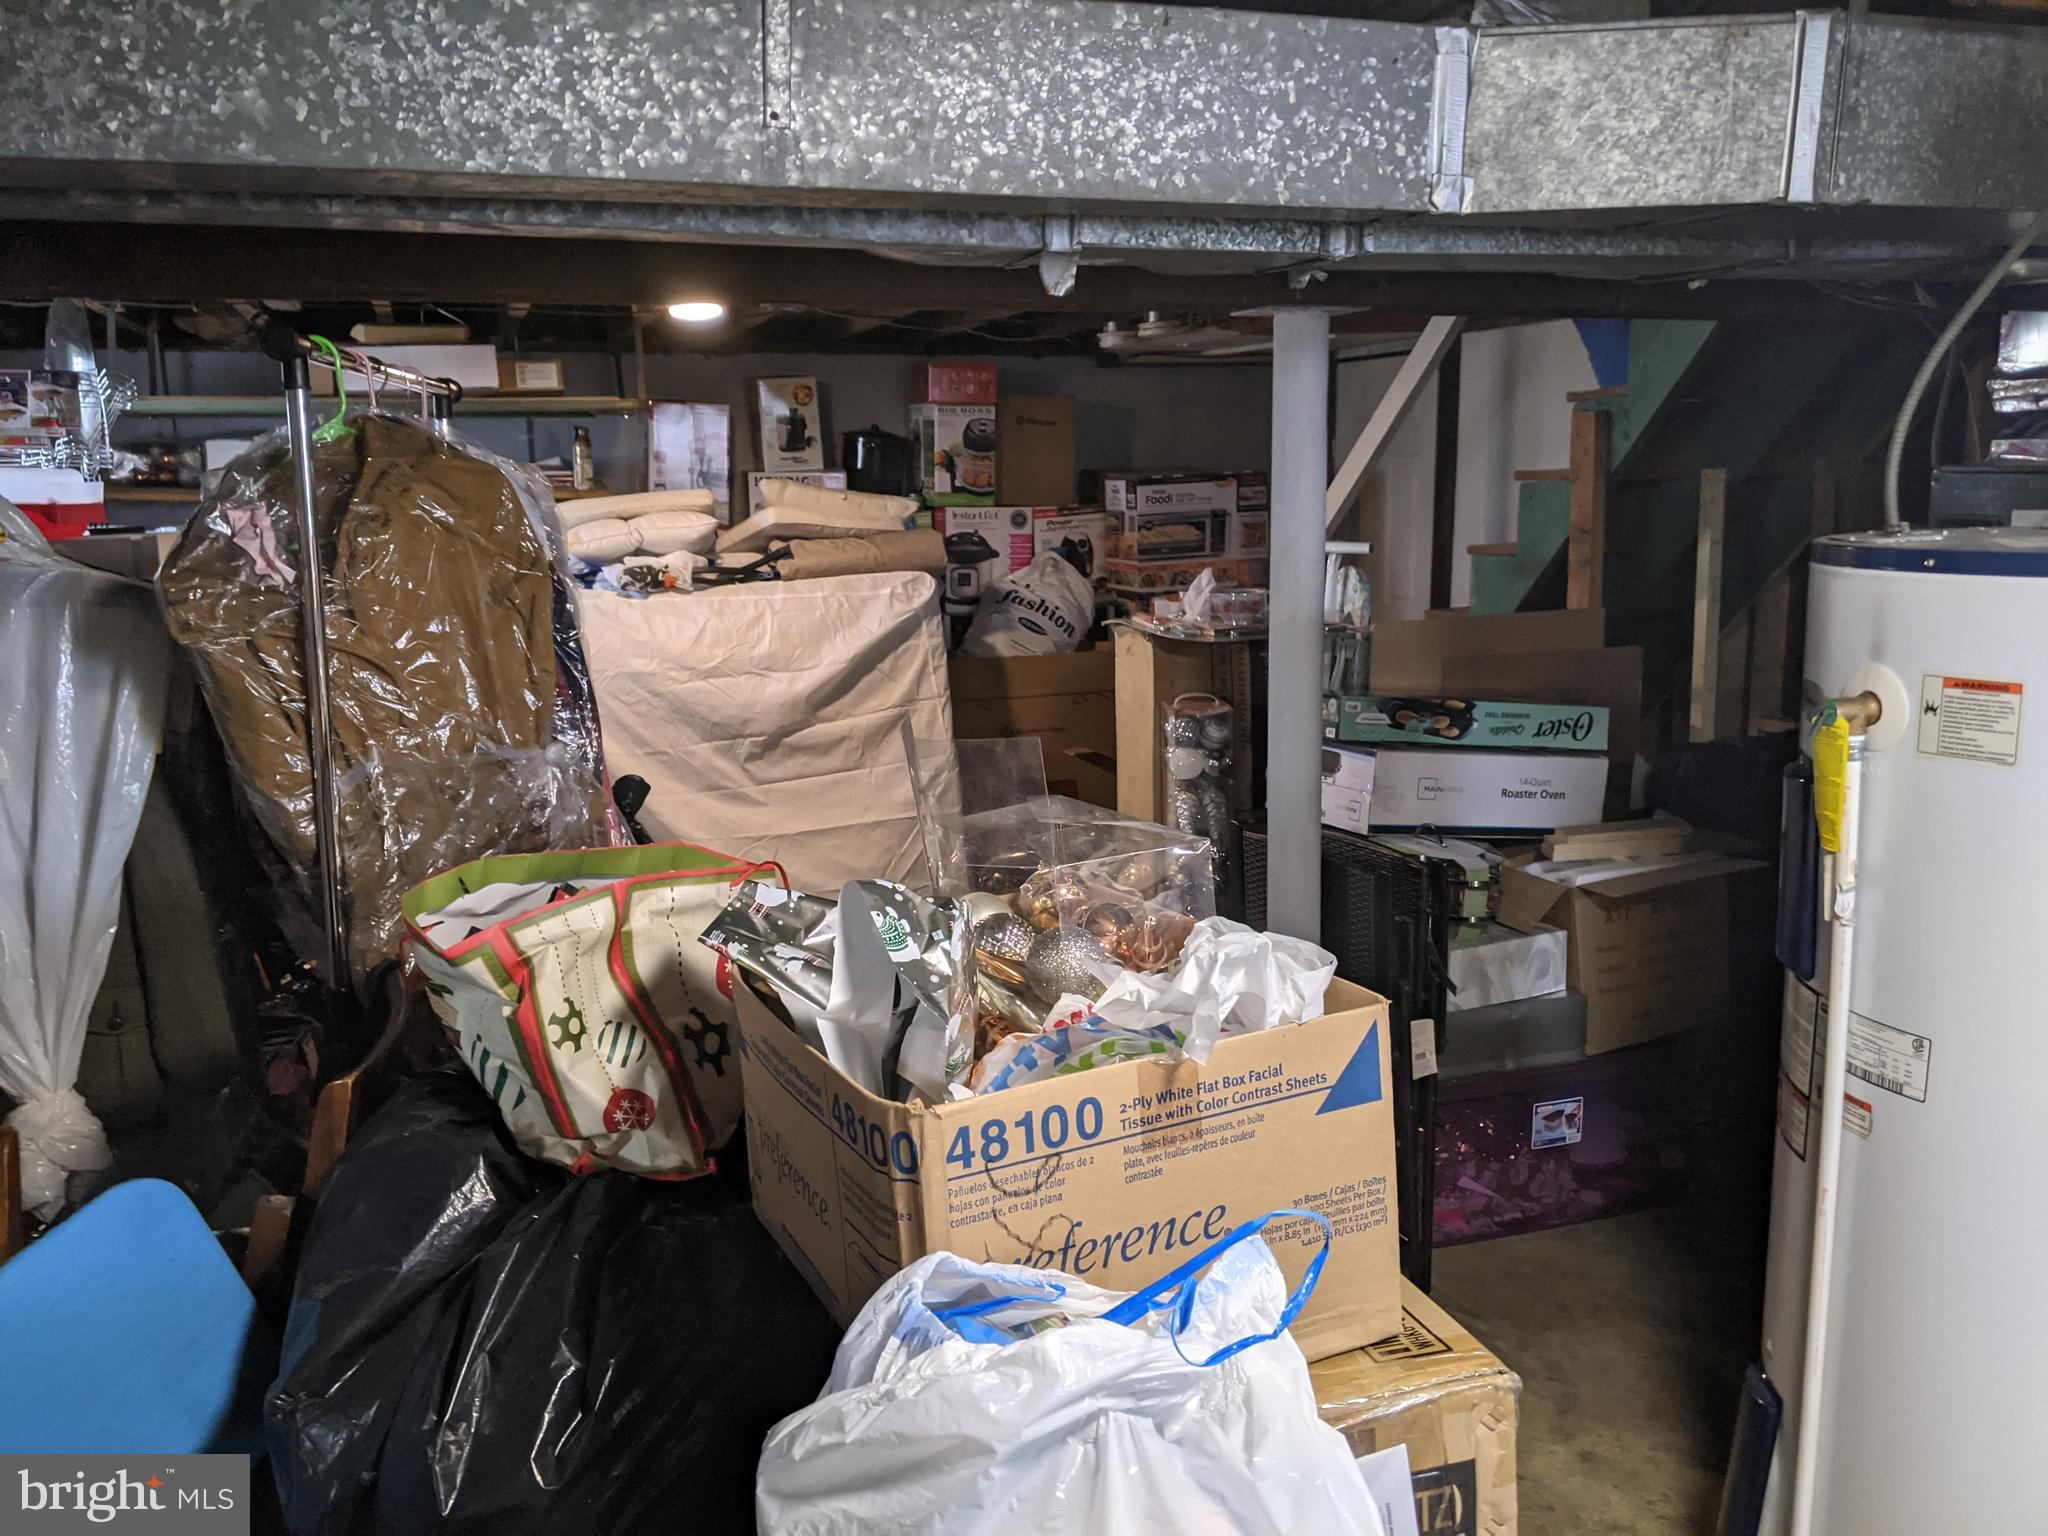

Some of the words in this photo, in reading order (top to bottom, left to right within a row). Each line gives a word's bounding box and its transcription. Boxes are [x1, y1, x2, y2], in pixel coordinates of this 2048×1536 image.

[1145, 494, 1173, 505] Foodi
[996, 589, 1076, 638] fashion
[1532, 711, 1594, 742] Oster
[1501, 788, 1538, 799] Roaster
[1540, 789, 1566, 800] Oven
[1519, 777, 1552, 787] 14-Quart
[1120, 1097, 1152, 1114] 2-Ply
[1155, 1086, 1193, 1106] White
[1197, 1080, 1219, 1096] Flat
[1223, 1075, 1246, 1089] Box
[1249, 1063, 1283, 1082] Facial
[1120, 1113, 1162, 1131] Tissue
[1165, 1104, 1193, 1121] with
[1198, 1095, 1229, 1113] Color
[1232, 1083, 1282, 1104] Contrast
[1285, 1072, 1327, 1092] Sheets
[832, 1092, 918, 1175] 48100
[945, 1096, 1103, 1170] 48100
[1123, 1138, 1161, 1155] Mouchoirs
[1237, 1118, 1246, 1127] en
[1124, 1158, 1145, 1172] plate,
[1146, 1154, 1163, 1165] avec
[1219, 1135, 1229, 1145] de
[1230, 1129, 1256, 1142] couleur
[948, 1181, 987, 1199] Pañuelos
[989, 1169, 1041, 1188] desechables
[1076, 1157, 1088, 1167] de
[1089, 1156, 1095, 1165] 2
[1125, 1166, 1163, 1184] contrastée
[949, 1200, 973, 1214] hojas
[974, 1195, 990, 1205] con
[1045, 1177, 1066, 1189] color
[1008, 1203, 1019, 1213] en
[1020, 1198, 1038, 1211] caja
[1040, 1192, 1063, 1206] plana
[1292, 1198, 1303, 1209] 30
[1304, 1191, 1328, 1204] Boxes
[1335, 1184, 1356, 1197] Cajas
[1326, 1195, 1352, 1208] Sheets
[1353, 1191, 1366, 1201] Per
[1367, 1187, 1382, 1198] Box
[1260, 1225, 1283, 1238] Hojas
[1284, 1220, 1299, 1231] por
[1352, 1203, 1365, 1215] par
[1284, 1229, 1302, 1241] 8.85
[1354, 1211, 1369, 1222] 224
[1370, 1205, 1388, 1218] mm)
